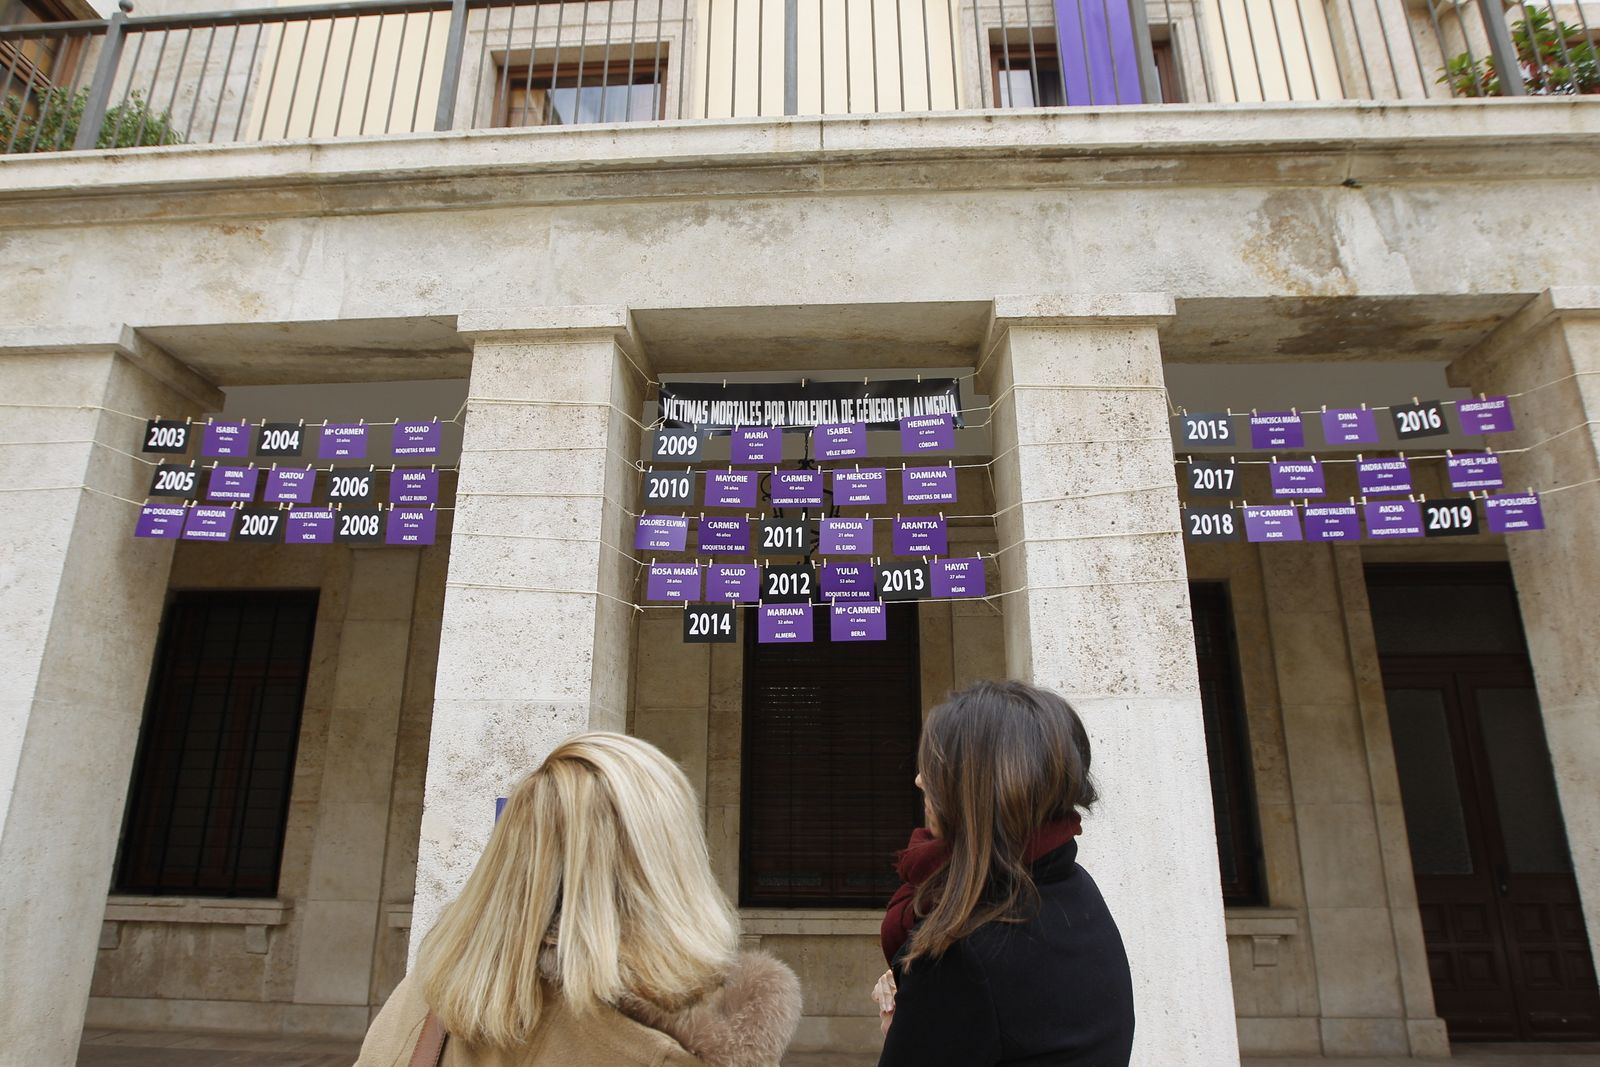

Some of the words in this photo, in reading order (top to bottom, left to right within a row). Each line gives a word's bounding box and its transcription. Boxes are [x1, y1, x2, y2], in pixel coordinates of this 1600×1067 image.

[663, 394, 708, 424] VÍCTIMAS
[711, 400, 762, 425] MORTALES
[765, 400, 785, 425] POR
[788, 400, 839, 425] VIOLENCIA
[841, 399, 855, 423] DE
[857, 393, 896, 423] GÉNERO
[897, 397, 910, 418] EN
[914, 390, 958, 416] ALMERÍA
[1251, 416, 1281, 425] FRANCISCA
[1337, 413, 1358, 421] DINA
[1397, 408, 1441, 433] 2016
[907, 418, 945, 428] HERMINIA
[216, 426, 239, 434] ISABEL
[404, 426, 429, 434] SOUAD
[827, 427, 852, 436] ISABEL
[1187, 420, 1229, 440] 2015
[148, 427, 185, 447] 2003
[744, 431, 768, 439] MARÍA
[261, 430, 299, 450] 2004
[657, 435, 697, 455] 2009
[1360, 463, 1383, 471] ANDRA
[1383, 462, 1407, 470] VIOLETA
[1461, 458, 1476, 467] DEL
[1476, 457, 1498, 465] PILAR
[1279, 465, 1314, 473] ANTONIA
[224, 470, 244, 478] IRINA
[279, 472, 304, 480] ISATOU
[403, 472, 426, 480] MARÍA
[715, 474, 748, 483] MAYORIE
[846, 472, 882, 480] MERCEDES
[910, 471, 947, 480] DAMIANA
[155, 471, 195, 491] 2005
[781, 475, 813, 483] CARMEN
[1193, 469, 1234, 490] 2017
[330, 477, 369, 497] 2006
[649, 478, 689, 498] 2010
[1500, 497, 1537, 507] DOLORES
[153, 508, 184, 516] DOLORES
[1260, 509, 1294, 517] CARMEN
[1379, 505, 1405, 513] AICHA
[400, 512, 424, 520] JUANA
[1428, 506, 1472, 530] 2019
[240, 515, 279, 536] 2007
[340, 515, 379, 536] 2008
[640, 519, 666, 527] DOLORES
[666, 520, 686, 528] ELVIRA
[708, 521, 739, 529] CARMEN
[829, 522, 863, 530] KHADIJA
[901, 522, 938, 530] ARANTXA
[1190, 514, 1234, 535] 2018
[763, 526, 803, 548] 2011
[651, 568, 672, 576] ROSA
[673, 567, 698, 576] MARÍA
[944, 563, 969, 571] HAYAT
[720, 568, 746, 576] SALUD
[768, 573, 810, 595] 2012
[881, 569, 925, 592] 2013
[767, 608, 804, 617] MARIANA
[835, 607, 846, 615] Mª
[847, 606, 881, 614] CARMEN
[689, 613, 731, 635] 2014
